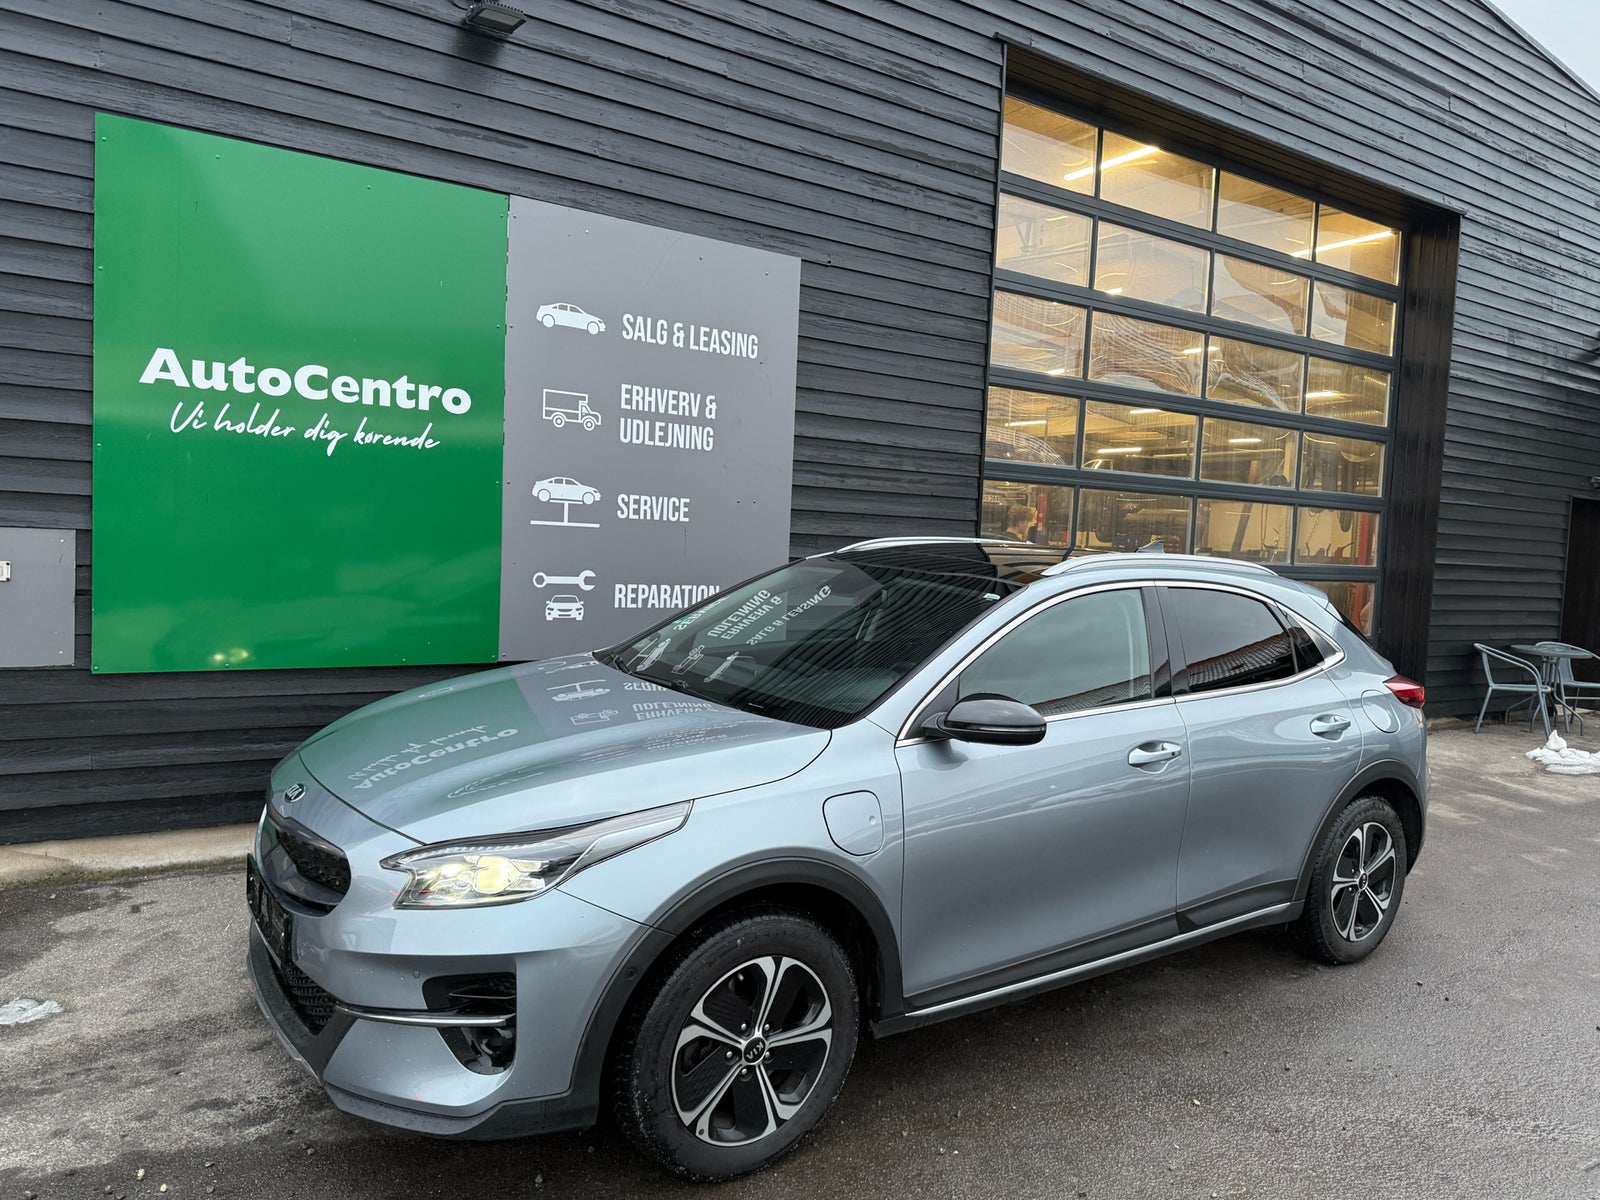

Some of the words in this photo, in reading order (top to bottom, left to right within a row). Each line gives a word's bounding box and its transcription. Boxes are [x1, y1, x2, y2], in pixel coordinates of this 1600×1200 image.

[622, 313, 667, 345] SALG
[672, 323, 685, 348] &
[689, 324, 759, 359] LEASING
[138, 347, 472, 415] AutoCentro
[620, 383, 701, 417] ERHVERV
[704, 394, 717, 420] &
[169, 401, 207, 434] Vi
[213, 402, 296, 438] holder
[303, 412, 348, 457] dig
[353, 416, 441, 450] kørende
[619, 417, 714, 451] UDLEJNING
[616, 493, 690, 522] SERVICE
[746, 1041, 764, 1060] KIA
